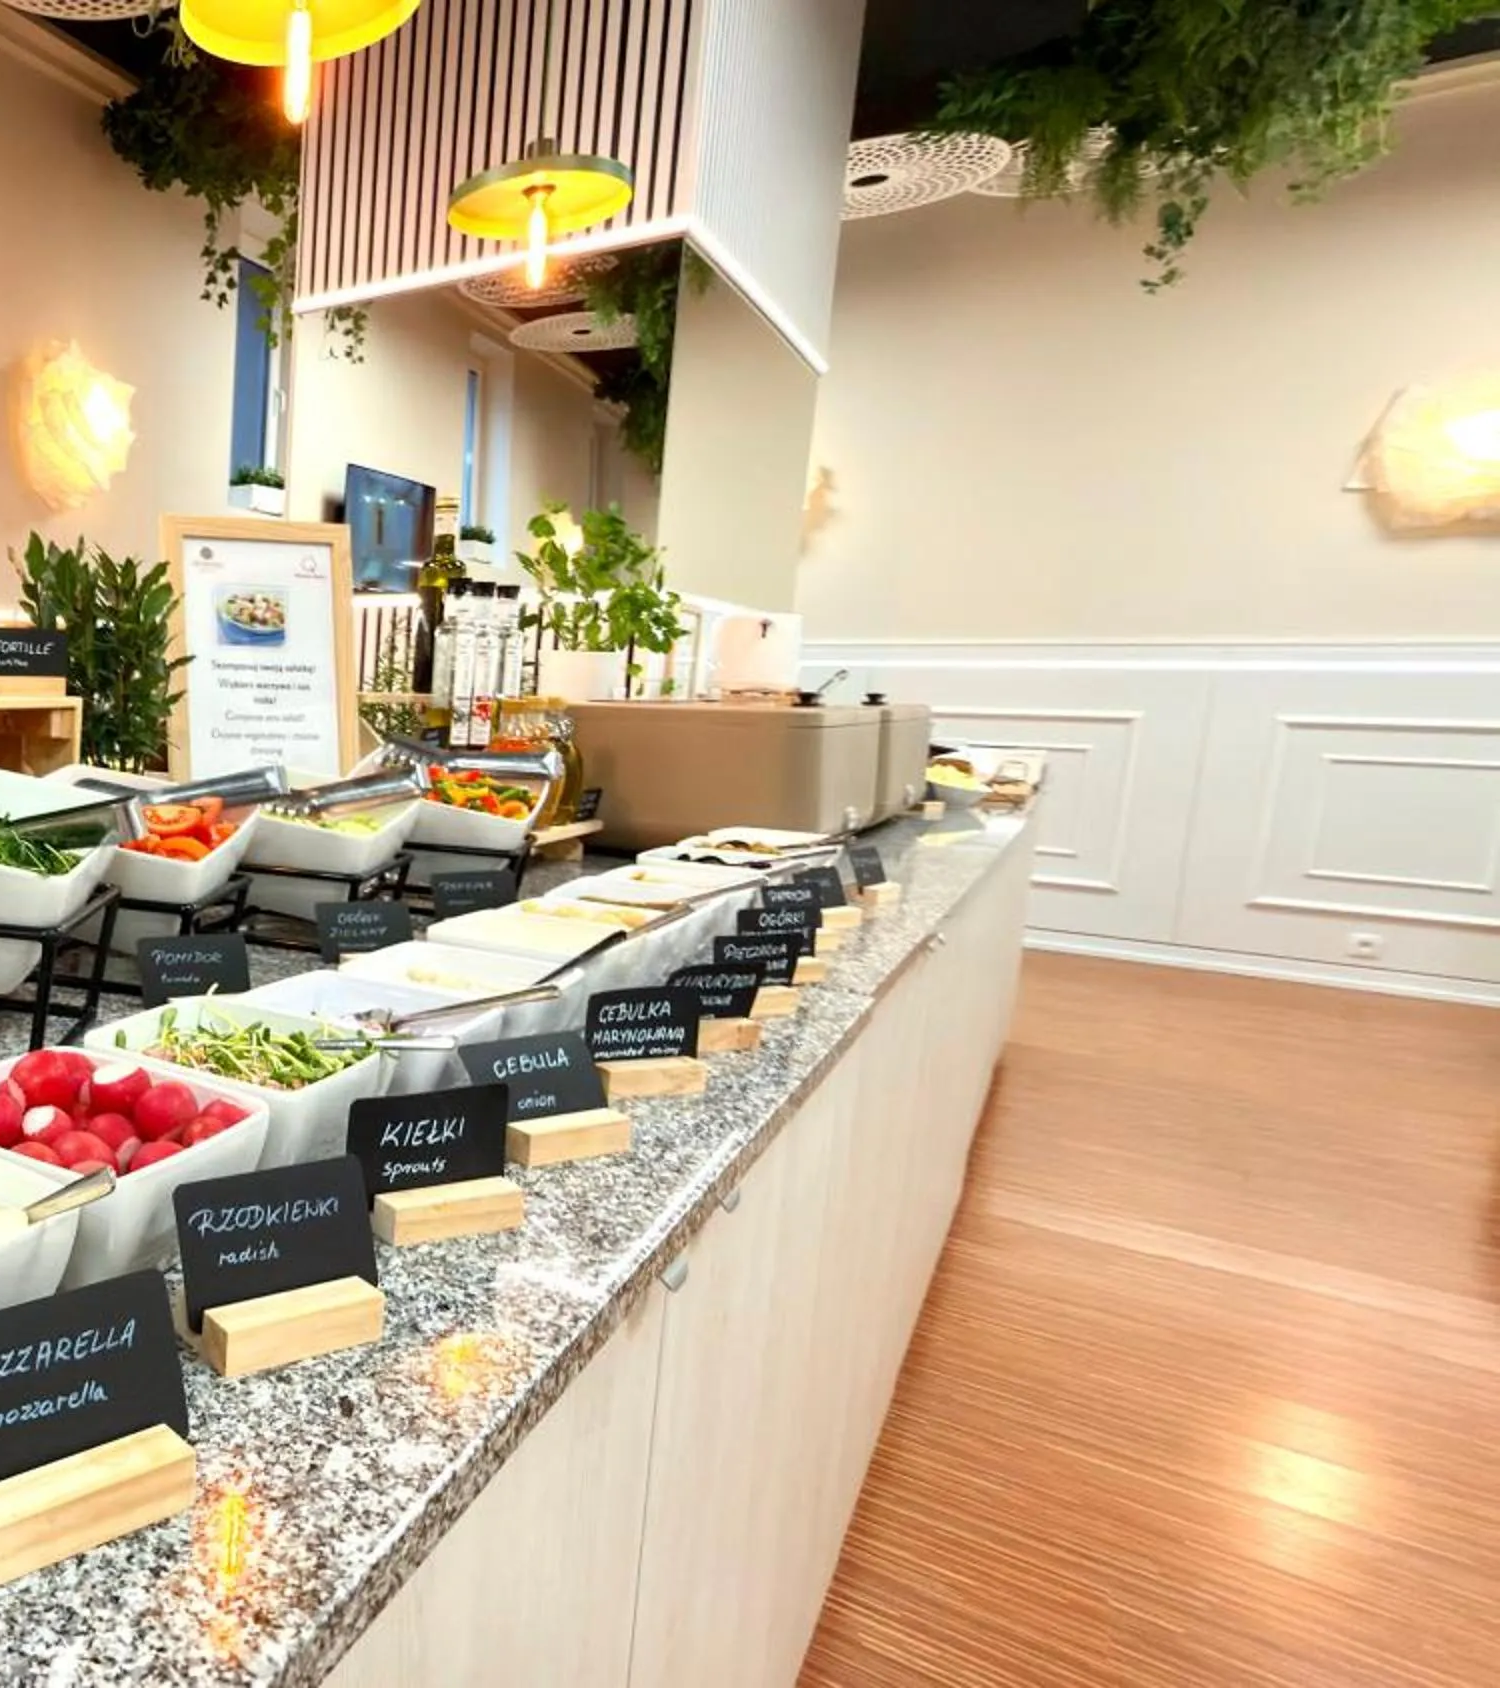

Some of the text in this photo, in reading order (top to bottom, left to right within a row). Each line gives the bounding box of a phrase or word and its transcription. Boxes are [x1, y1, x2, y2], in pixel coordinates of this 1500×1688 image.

[598, 1000, 672, 1024] CEBULKA
[591, 1025, 686, 1044] MARYNOWANA
[493, 1046, 571, 1080] CEBULA
[516, 1089, 558, 1110] onion
[379, 1115, 466, 1148] KIEŁKI
[380, 1156, 449, 1185] sprouts
[218, 1240, 281, 1267] radish
